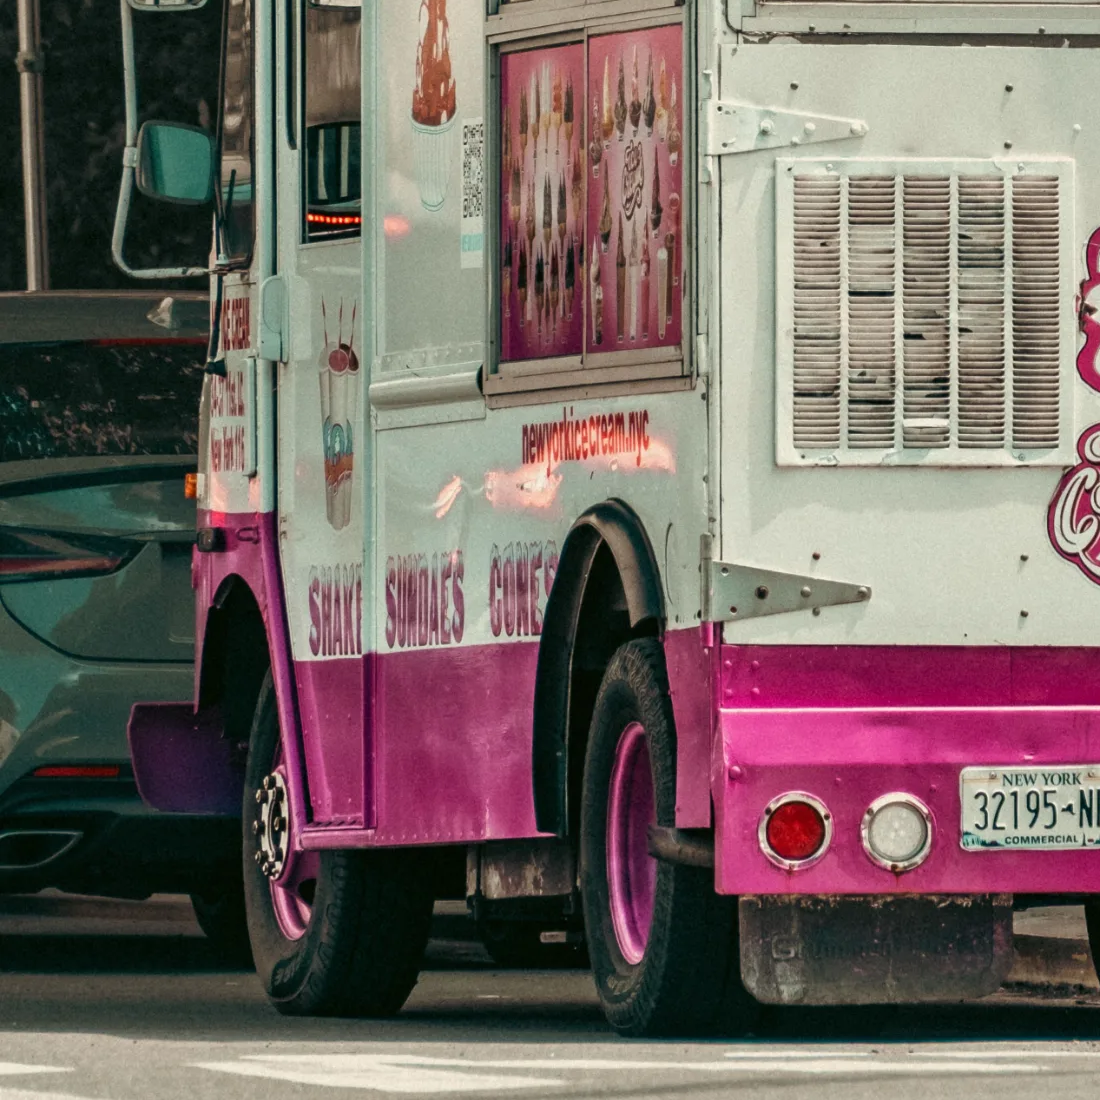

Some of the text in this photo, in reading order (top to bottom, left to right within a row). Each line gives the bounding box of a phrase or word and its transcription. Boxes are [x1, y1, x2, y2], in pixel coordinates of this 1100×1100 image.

[522, 406, 650, 477] newyorkicecream.nyc
[385, 549, 465, 649] SUNDAES
[1002, 772, 1082, 787] NEW YORK
[974, 789, 1057, 831] 32195
[1004, 834, 1079, 845] COMMERCIAL
